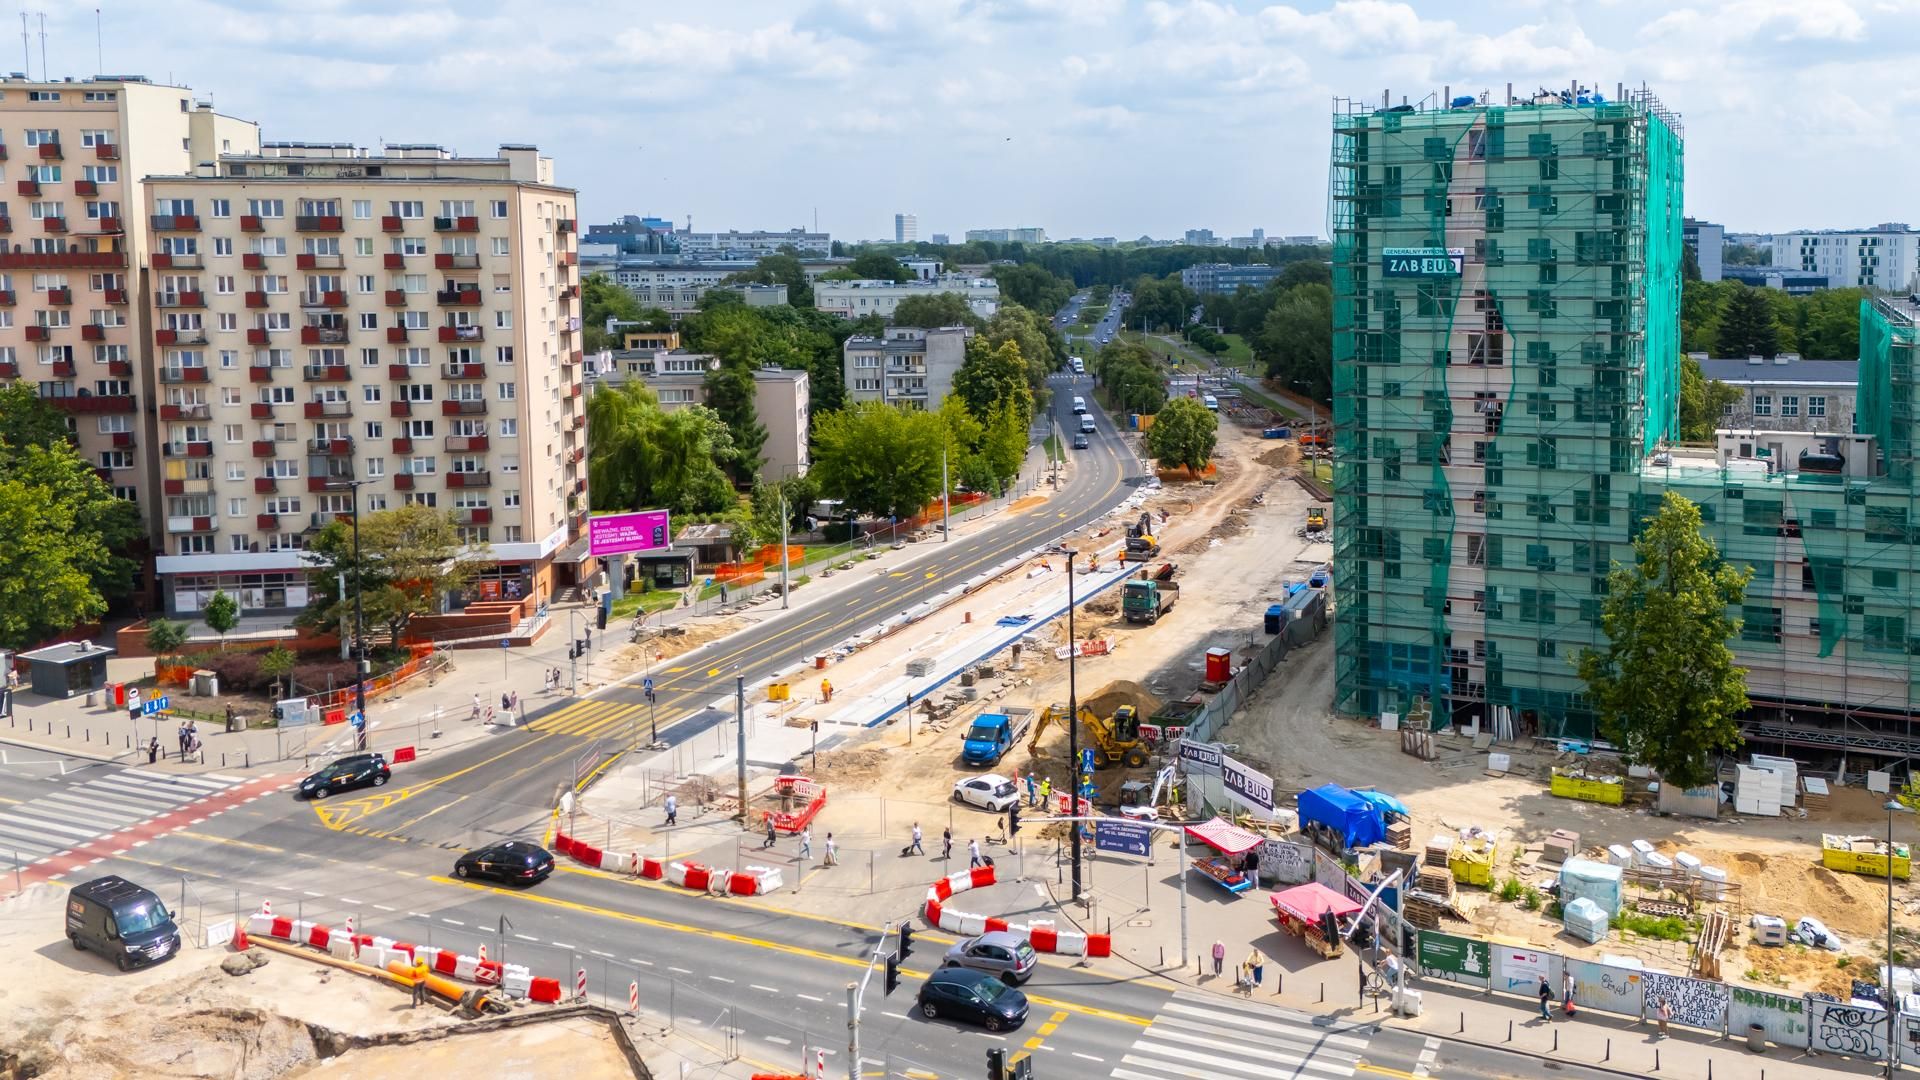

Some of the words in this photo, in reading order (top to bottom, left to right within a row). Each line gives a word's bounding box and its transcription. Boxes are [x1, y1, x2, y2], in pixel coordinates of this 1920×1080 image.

[1644, 973, 1654, 981] NA
[1644, 980, 1680, 992] DZIECKA
[1645, 987, 1677, 999] ZARABIA
